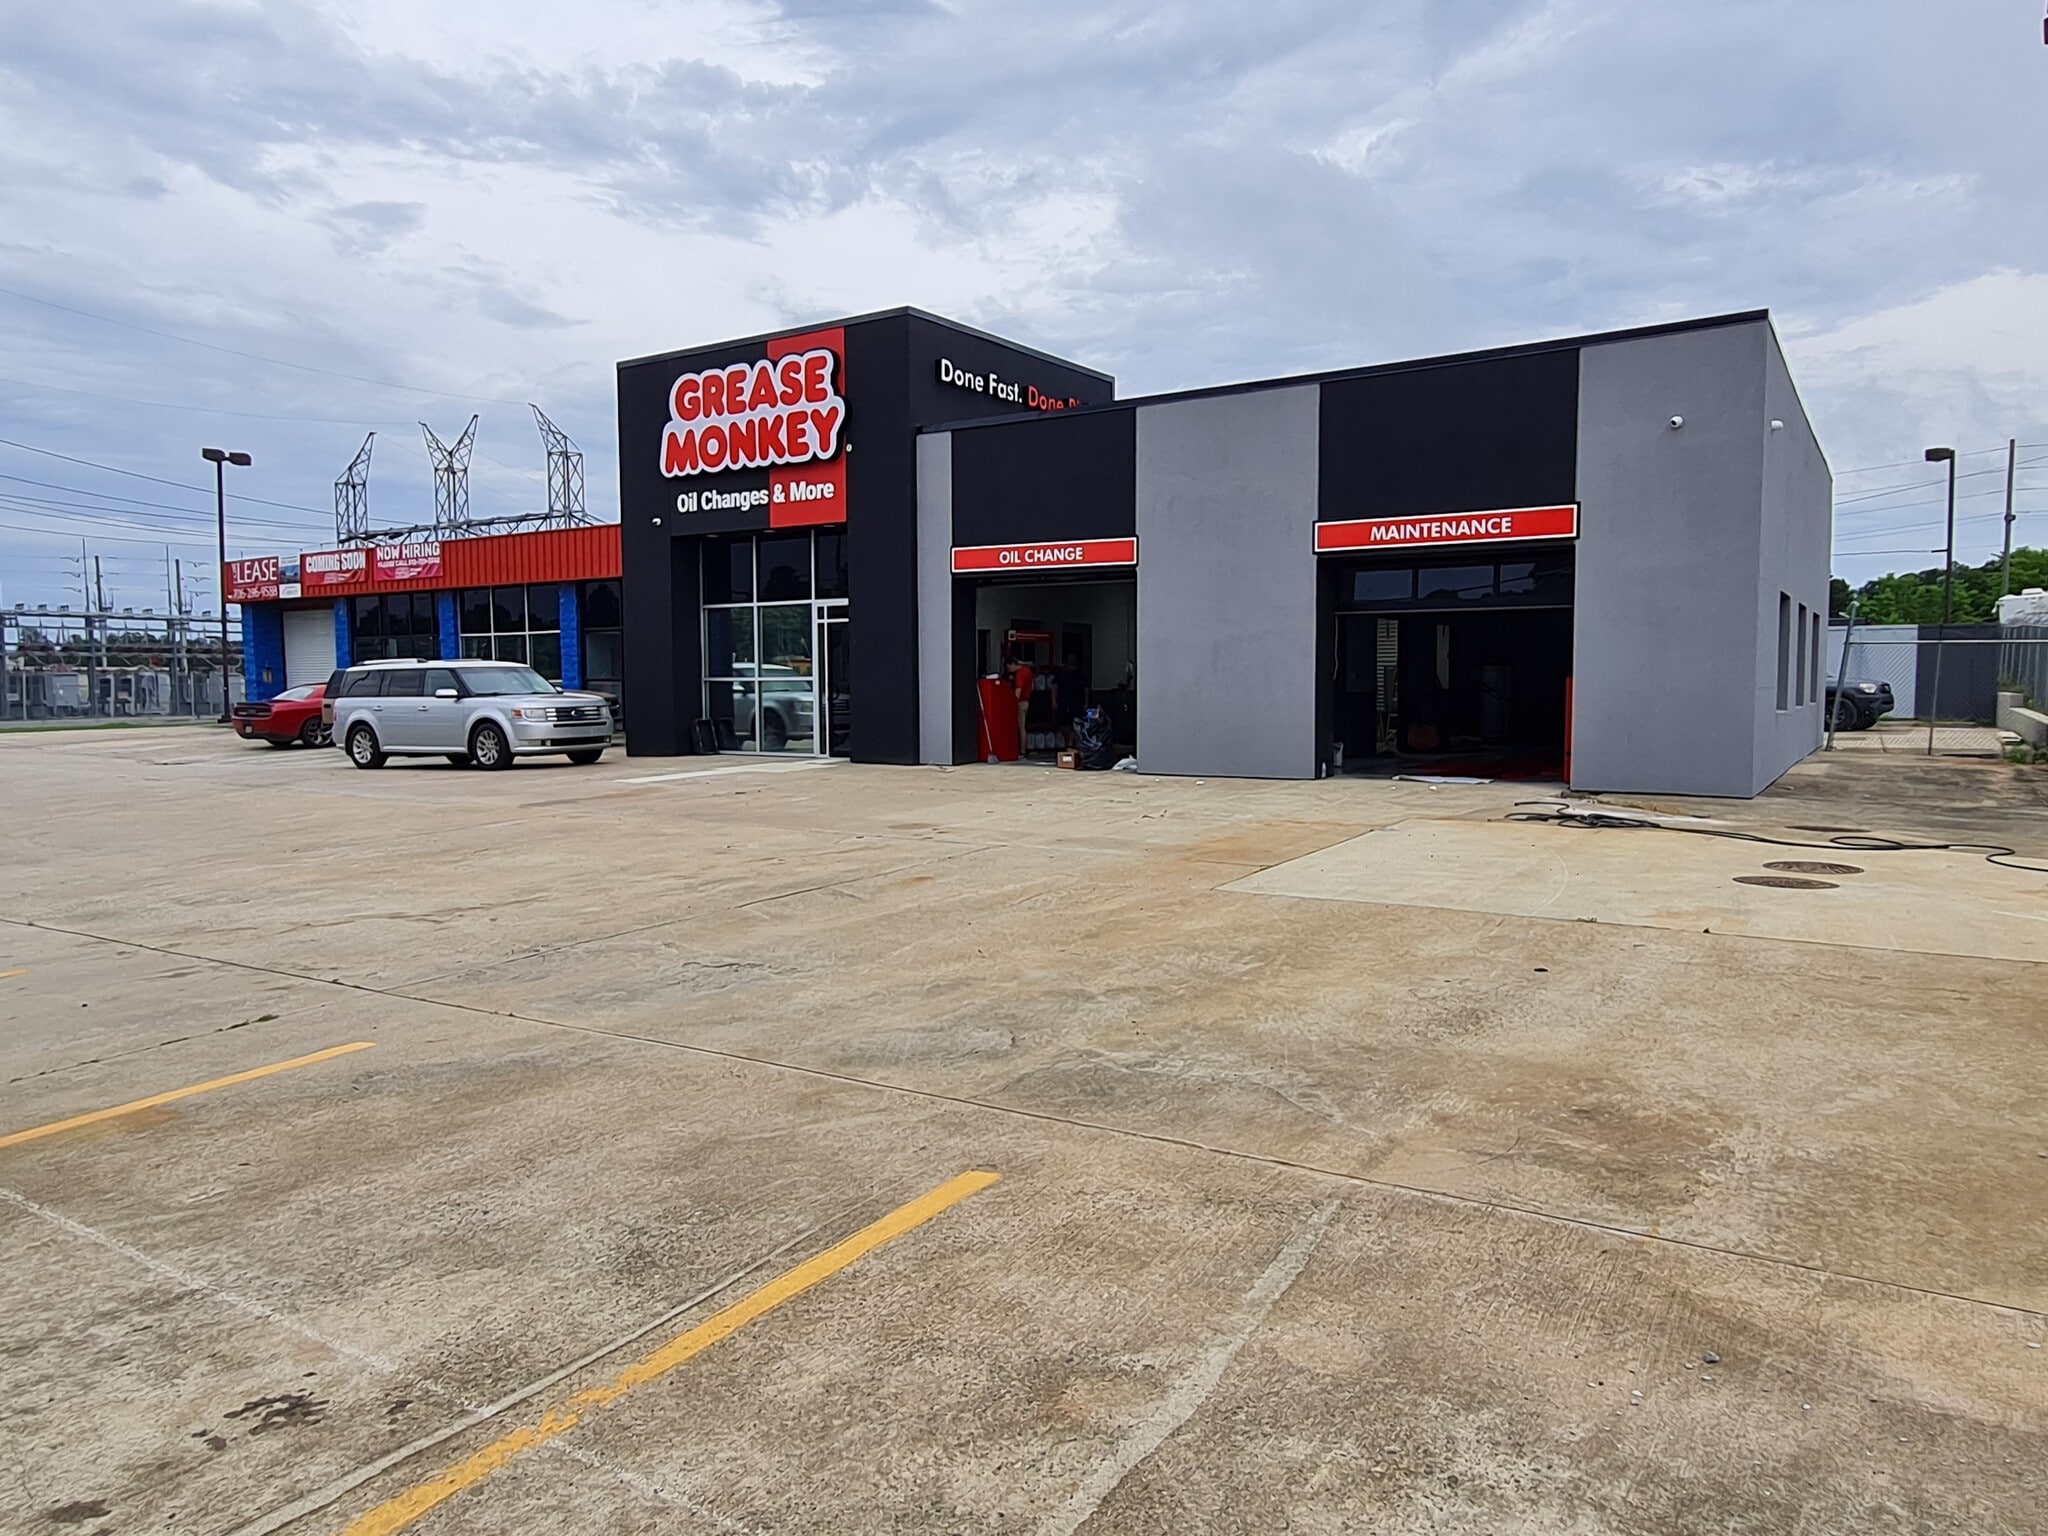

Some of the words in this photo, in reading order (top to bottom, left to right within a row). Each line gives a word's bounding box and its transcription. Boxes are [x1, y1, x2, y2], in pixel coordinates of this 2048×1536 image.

[675, 355, 828, 421] GREASE
[941, 358, 984, 392] Done
[989, 373, 1023, 403] Fast.
[665, 406, 839, 474] MONKEY
[677, 491, 698, 513] Oil
[701, 489, 769, 511] Changes
[772, 483, 786, 503] &
[789, 481, 835, 502] More
[1370, 517, 1512, 542] MAINTENANCE
[306, 553, 340, 573] COMING
[341, 551, 366, 570] SOON
[376, 545, 400, 561] NOW
[402, 541, 440, 559] HIRING
[999, 550, 1022, 564] OIL
[1024, 547, 1083, 563] CHANGE
[237, 559, 278, 583] LEASE
